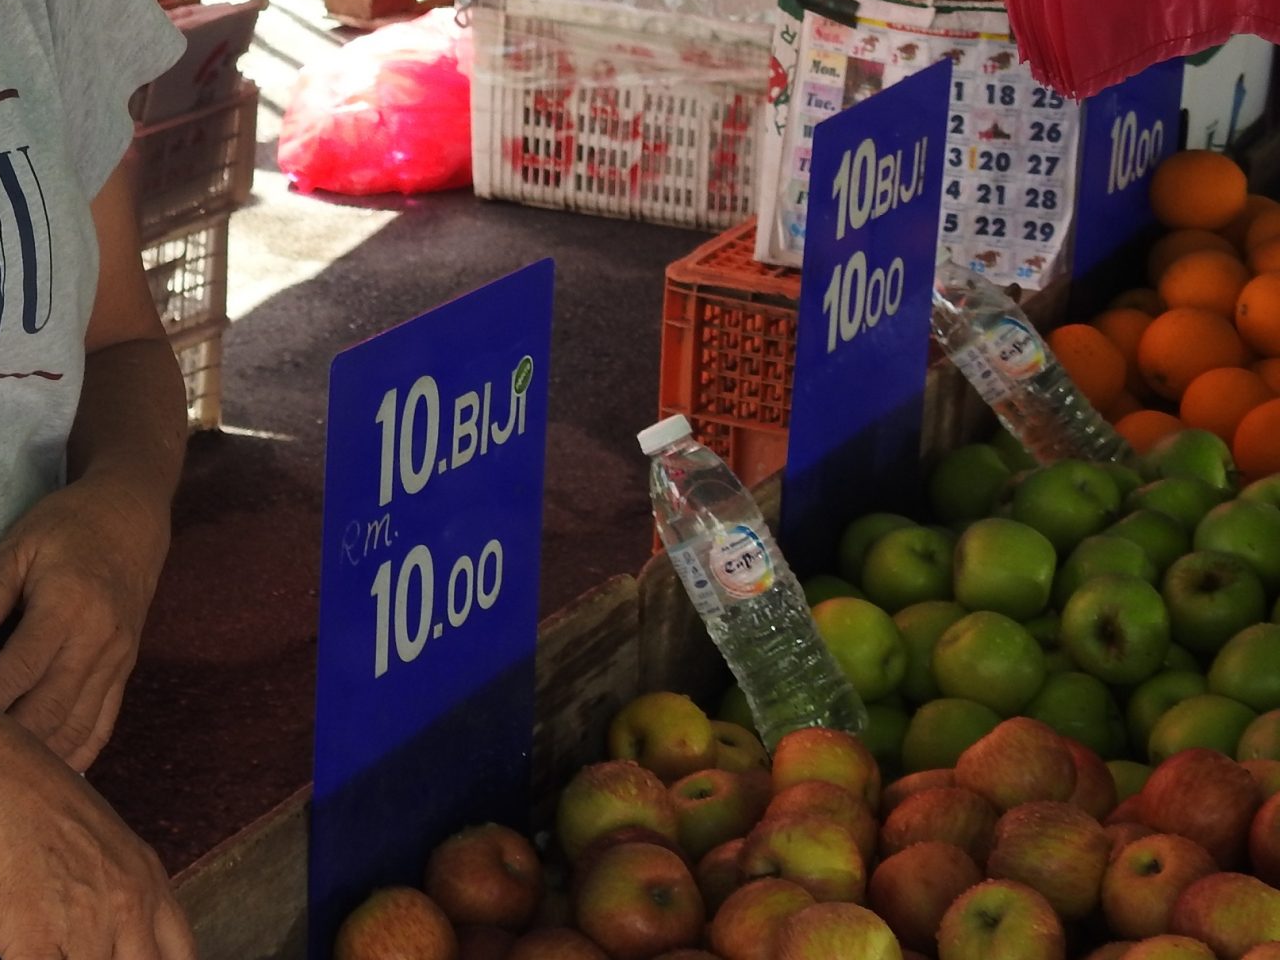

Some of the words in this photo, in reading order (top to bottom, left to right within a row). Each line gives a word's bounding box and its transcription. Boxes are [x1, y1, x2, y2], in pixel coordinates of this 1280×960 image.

[812, 58, 841, 78] Mon.
[986, 84, 1015, 106] 18
[1032, 87, 1064, 109] 25
[1030, 121, 1062, 143] 26
[979, 151, 1011, 172] 20
[1027, 154, 1061, 176] 27
[977, 184, 1006, 205] 21
[1025, 188, 1057, 210] 28
[975, 216, 1006, 238] 22
[1023, 221, 1055, 242] 29
[370, 539, 503, 679] 10.00
